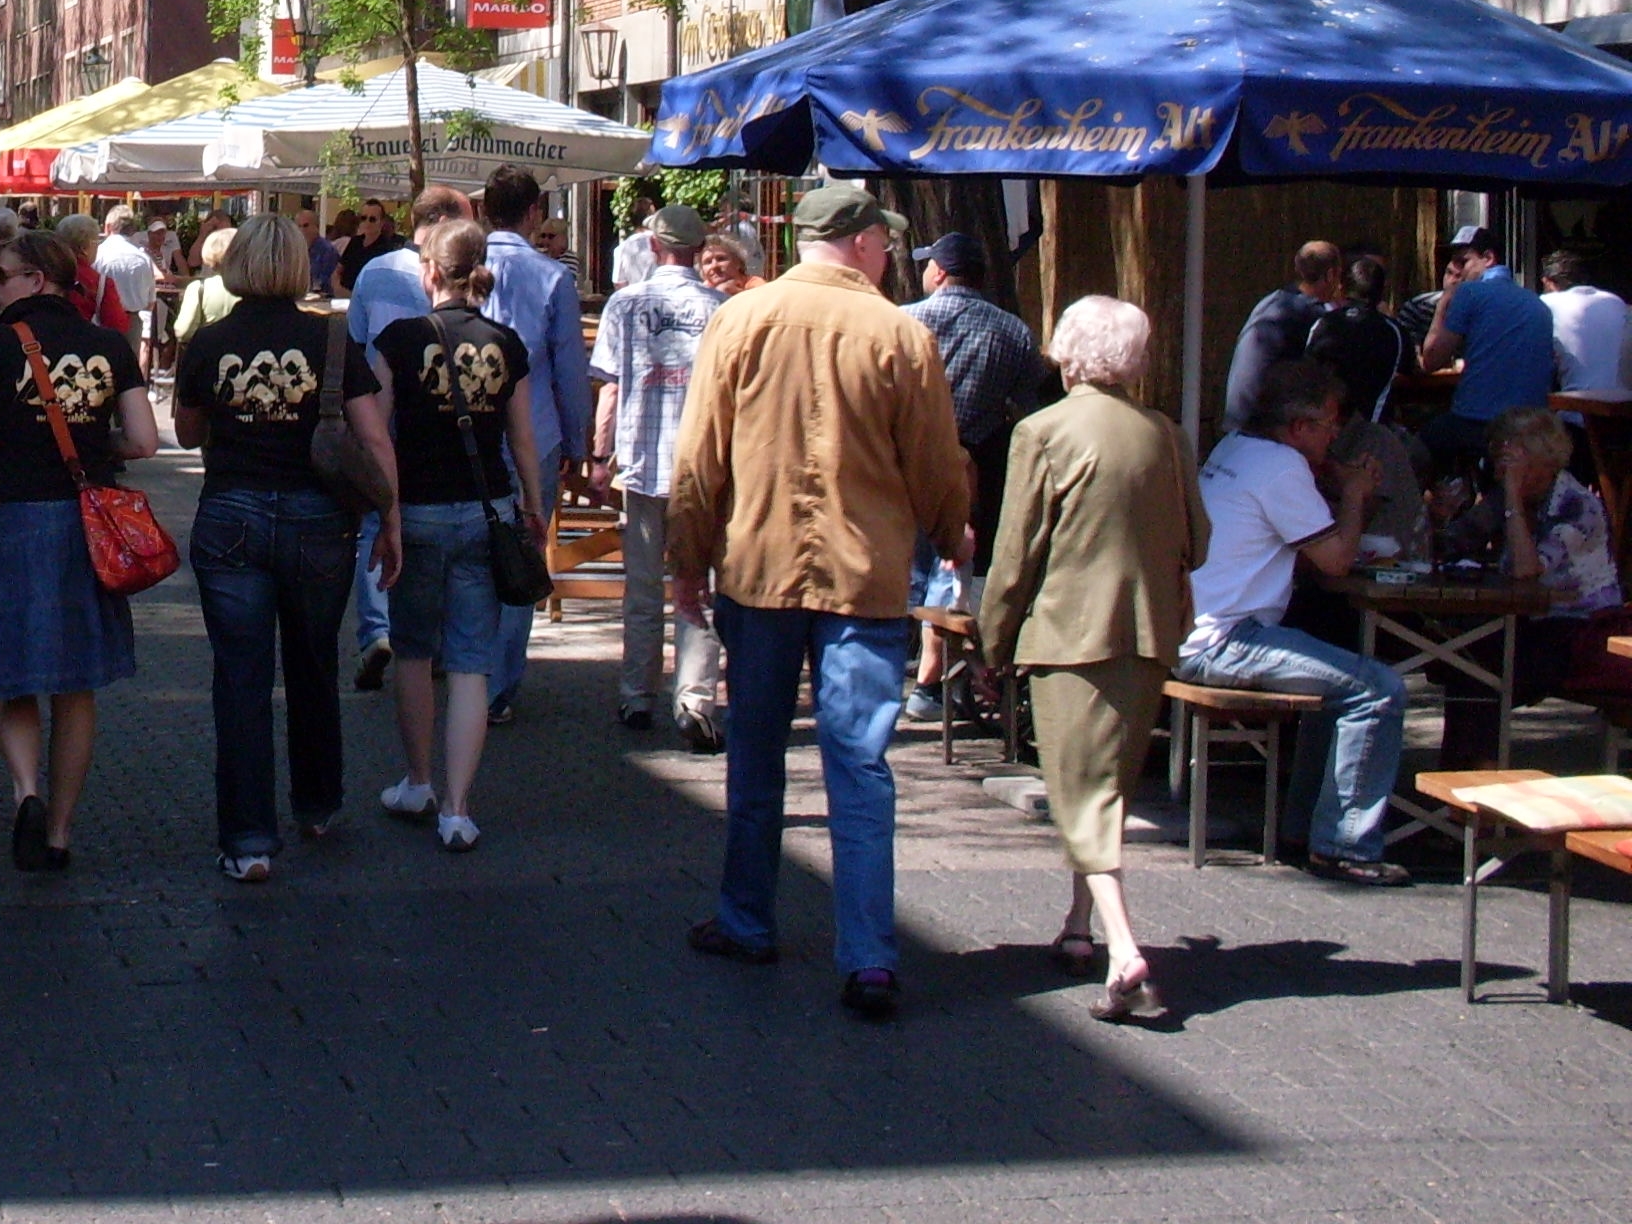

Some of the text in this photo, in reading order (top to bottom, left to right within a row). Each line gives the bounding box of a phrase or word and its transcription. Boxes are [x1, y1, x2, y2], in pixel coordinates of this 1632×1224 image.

[350, 131, 568, 160] Braueei Schumacher
[909, 84, 1216, 160] Frankenheim Alt
[1329, 91, 1552, 169] Frankenheim
